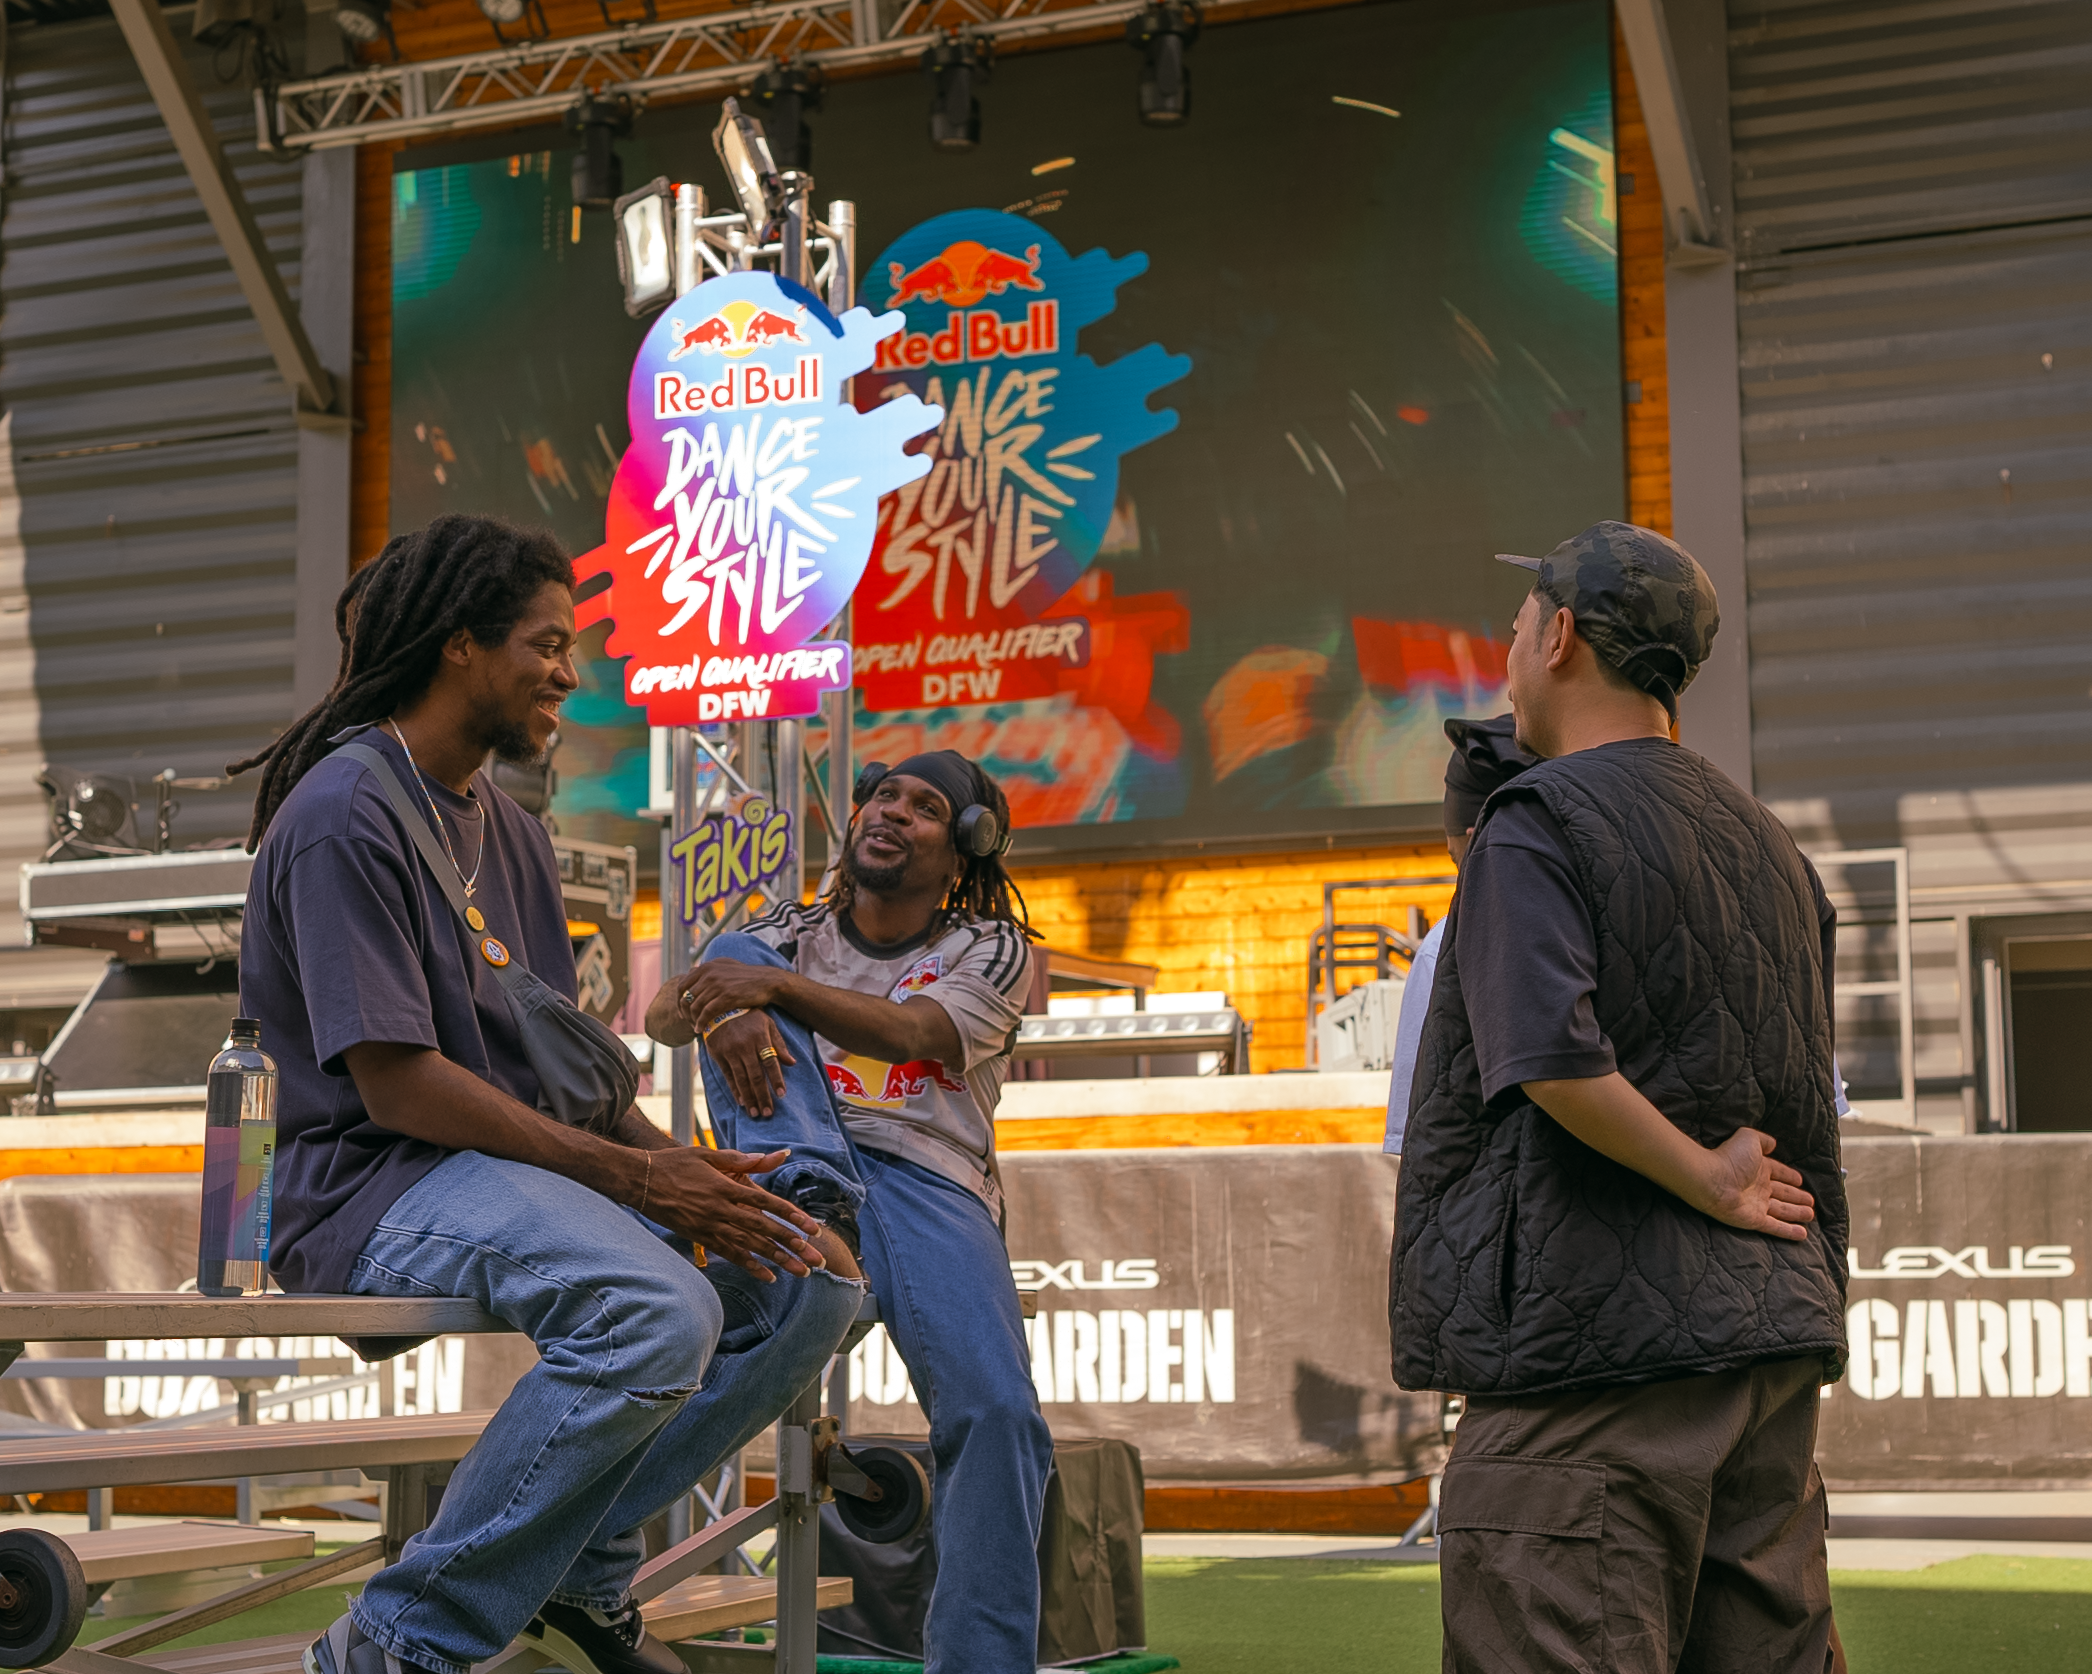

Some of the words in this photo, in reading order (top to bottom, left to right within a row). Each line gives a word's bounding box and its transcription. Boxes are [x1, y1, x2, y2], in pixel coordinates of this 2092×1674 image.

[873, 313, 962, 370] Red
[967, 303, 1056, 359] Bull
[659, 367, 735, 415] Red
[744, 357, 819, 406] Bull
[879, 366, 1061, 458] ANCE
[653, 412, 825, 512] DANCE
[670, 465, 840, 571] YOUR
[657, 519, 828, 647] STYLE
[877, 483, 1063, 621] STYLE
[630, 653, 701, 694] OPEN
[700, 647, 845, 690] QUALIFIER
[853, 631, 923, 675] OPEN
[924, 622, 1085, 668] QUALIFIER
[699, 688, 772, 721] DFW
[923, 668, 1002, 704] DFW
[670, 797, 791, 925] Takis
[1010, 1258, 1160, 1290] EXUS
[1848, 1246, 2076, 1279] LEXUS
[1022, 1308, 1236, 1403] ARDEN
